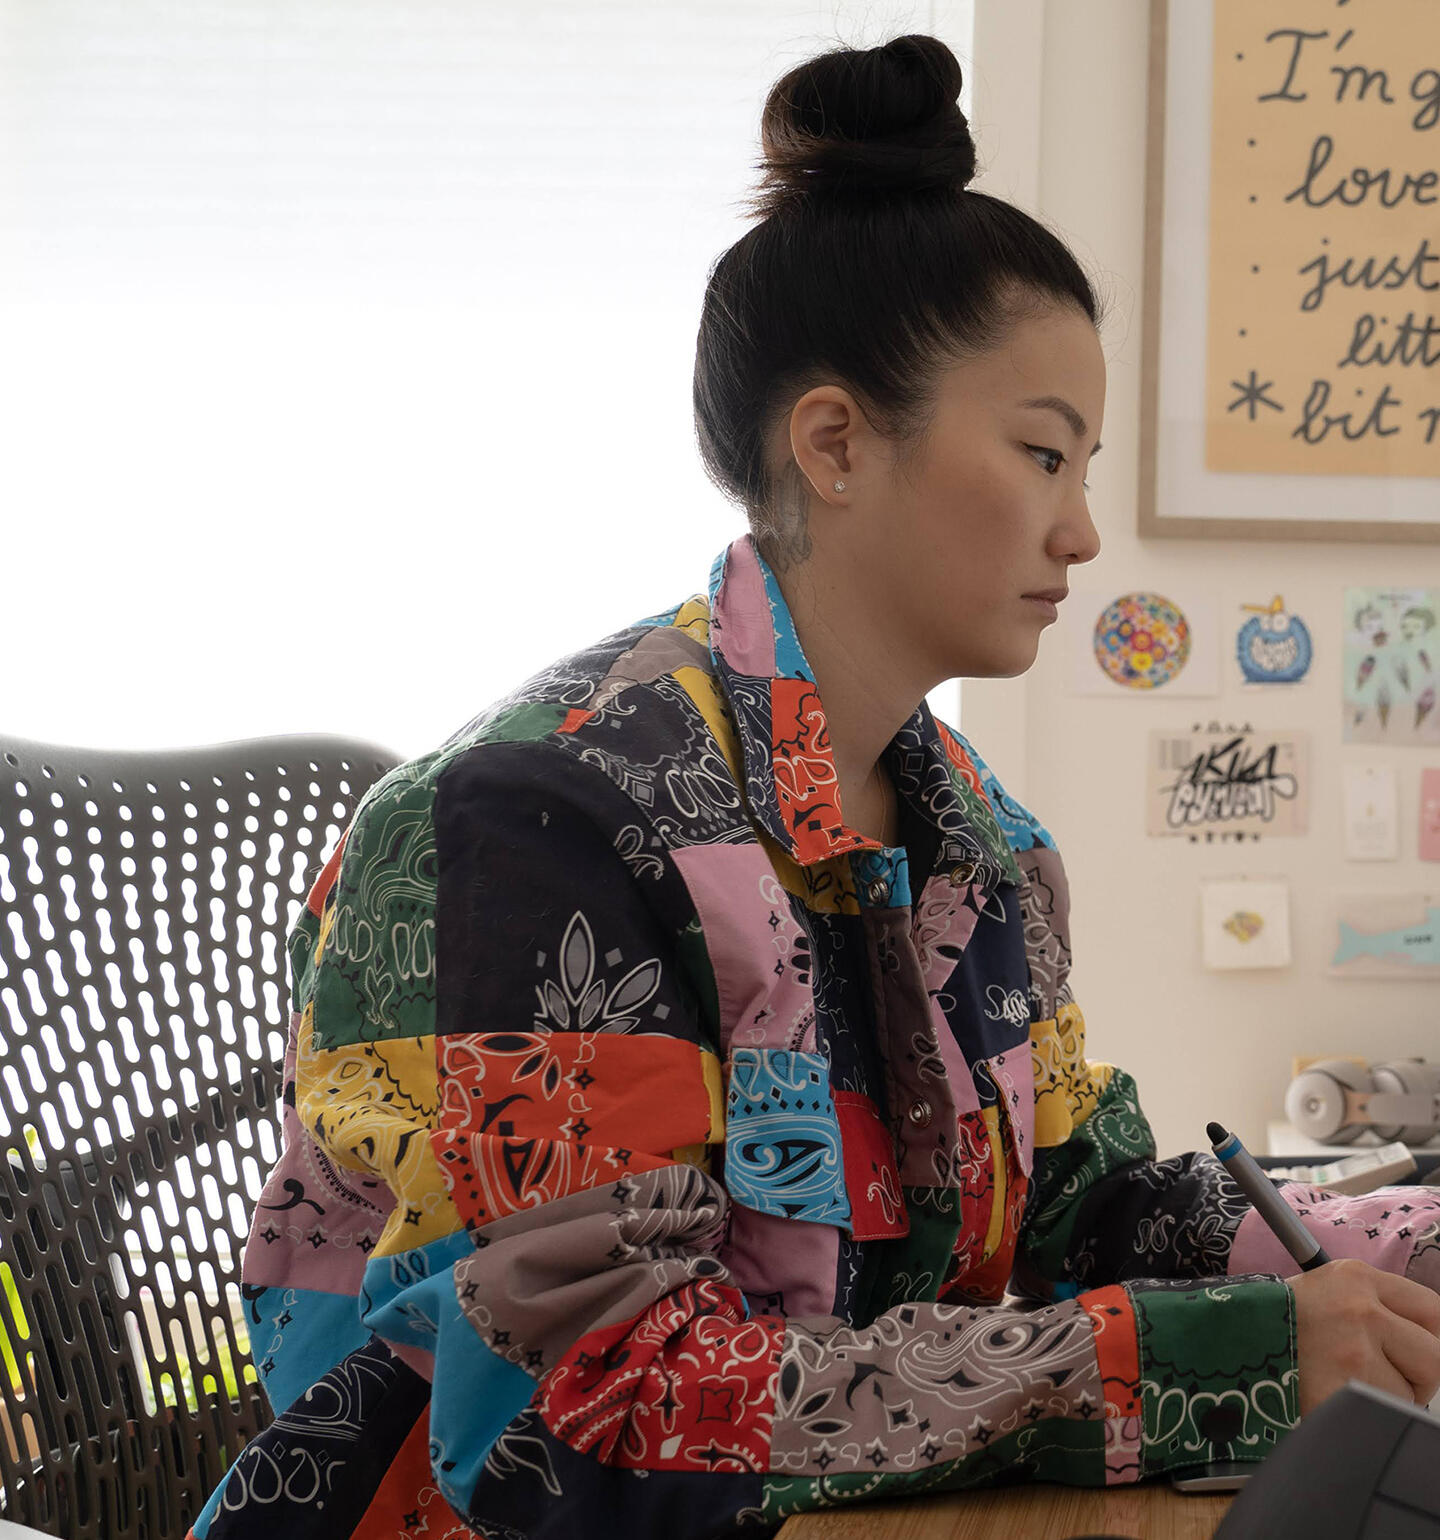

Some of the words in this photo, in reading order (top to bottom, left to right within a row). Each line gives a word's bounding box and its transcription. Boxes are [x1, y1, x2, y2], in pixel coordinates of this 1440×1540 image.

[1257, 28, 1395, 105] I'm
[1283, 134, 1440, 210] love
[1291, 379, 1402, 446] bit
